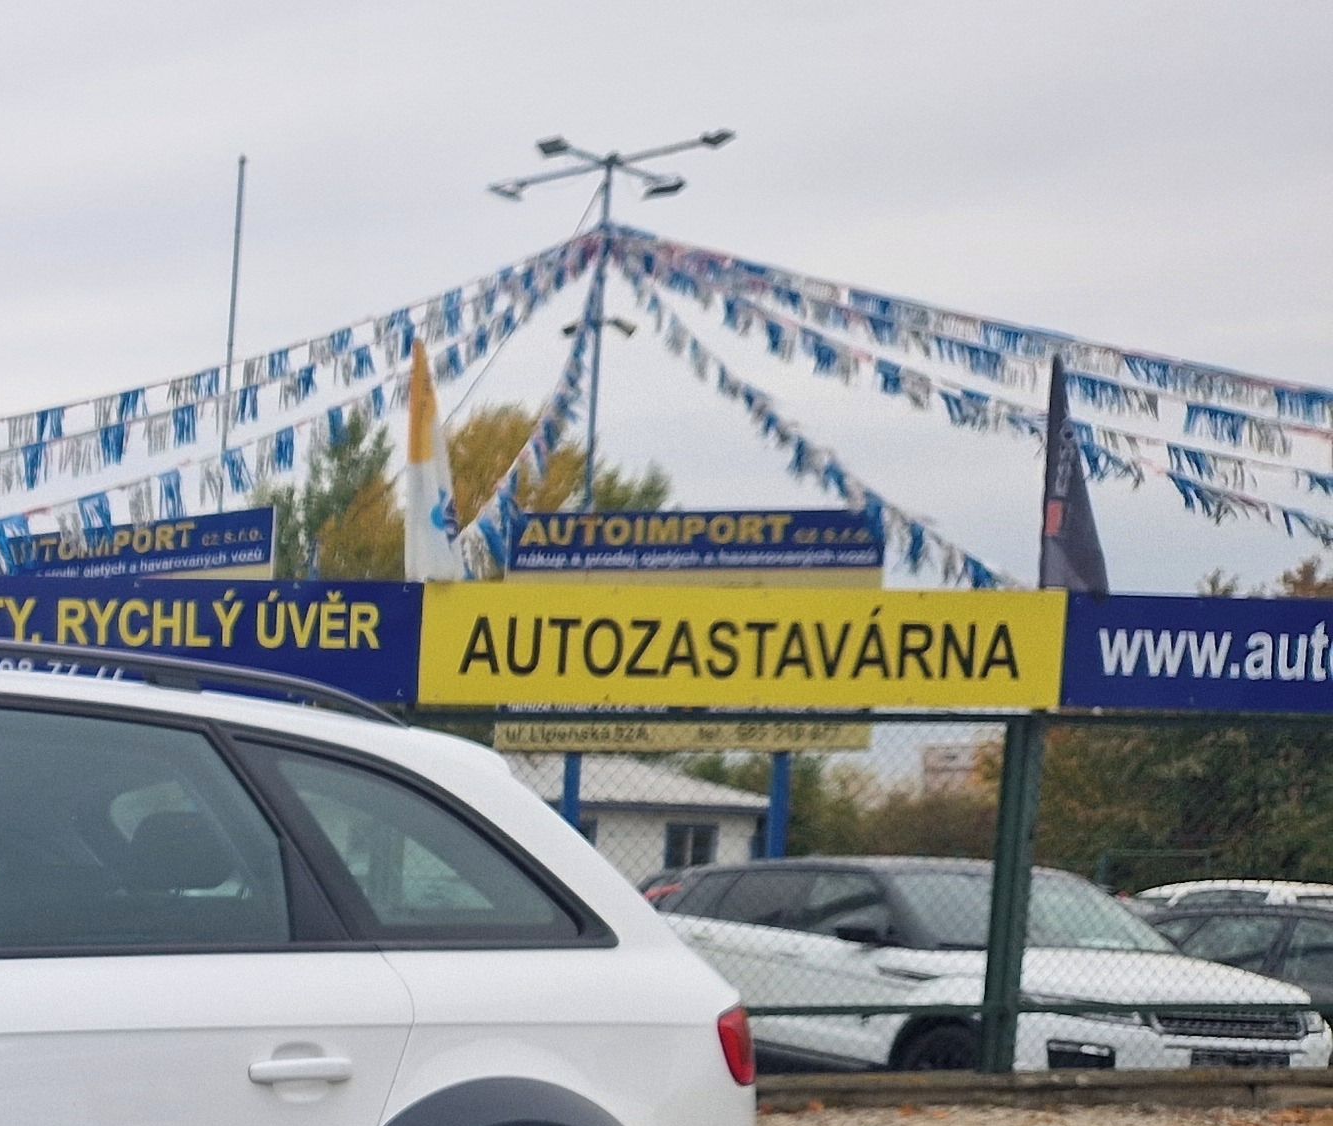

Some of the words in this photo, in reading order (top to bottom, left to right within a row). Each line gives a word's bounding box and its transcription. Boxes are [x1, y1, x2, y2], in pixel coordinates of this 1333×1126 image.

[518, 514, 793, 547] AUTOIMPORT
[56, 588, 245, 648] RYCHLÝ
[255, 588, 381, 650] ÚVĚR
[457, 606, 1021, 681] AUTOZASTAVÁRNA
[1098, 620, 1333, 682] www.aut
